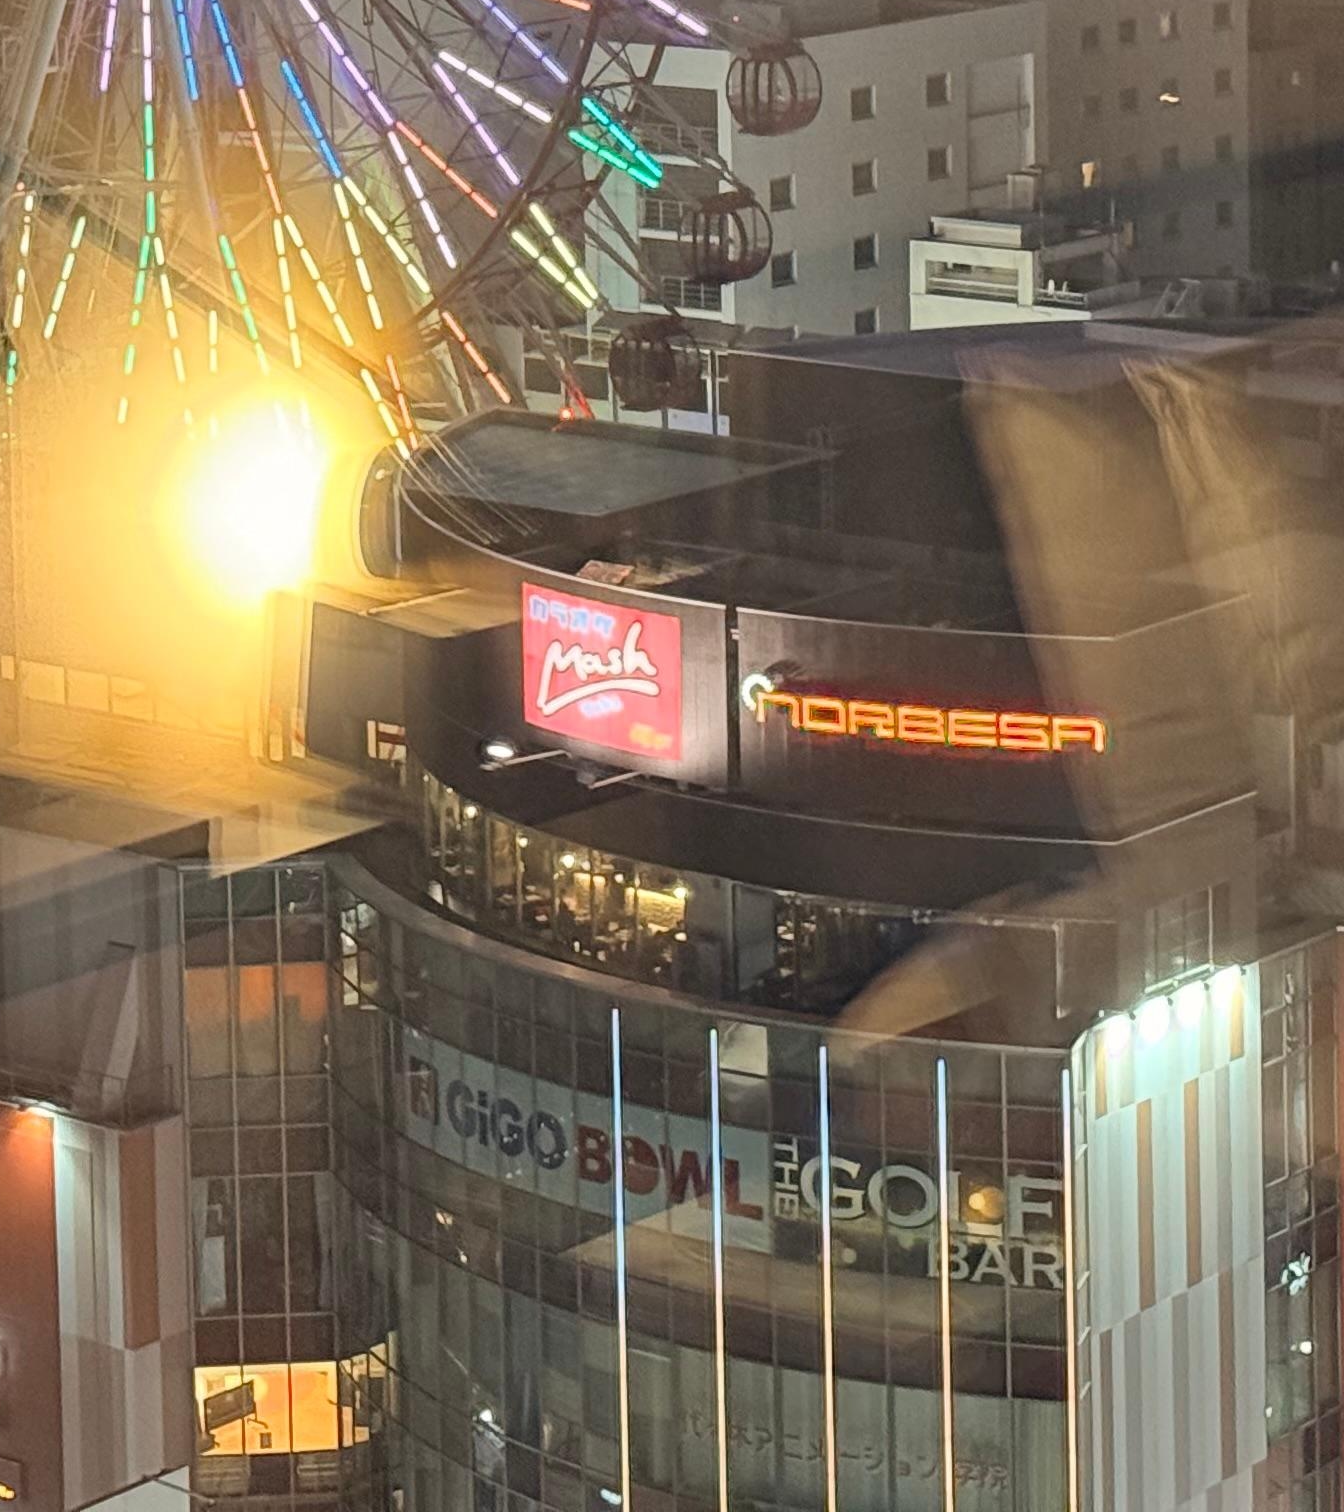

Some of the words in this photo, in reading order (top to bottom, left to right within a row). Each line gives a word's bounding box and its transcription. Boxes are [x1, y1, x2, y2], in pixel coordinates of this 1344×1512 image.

[537, 620, 659, 708] Mash
[757, 691, 1105, 753] NORBESA
[576, 1124, 763, 1221] BOWL
[773, 1134, 799, 1219] THE
[800, 1155, 1063, 1237] GOLF
[927, 1239, 1064, 1289] BAR
